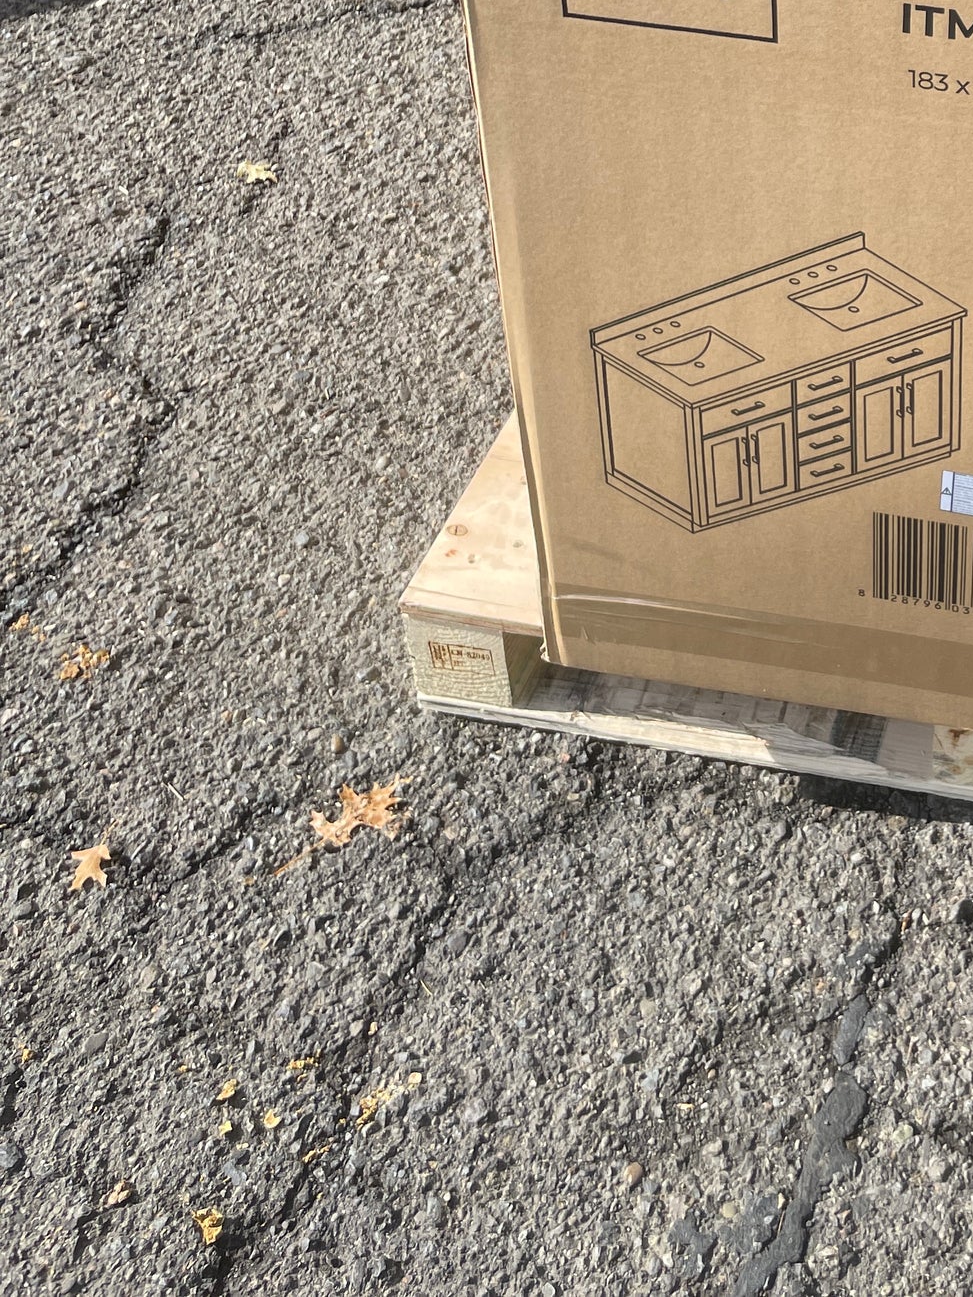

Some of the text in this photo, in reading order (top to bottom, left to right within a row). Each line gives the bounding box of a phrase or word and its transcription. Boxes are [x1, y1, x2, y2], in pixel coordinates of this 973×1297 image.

[907, 69, 949, 93] 183
[955, 79, 971, 95] x
[858, 589, 865, 597] 8
[890, 594, 942, 610] 28796
